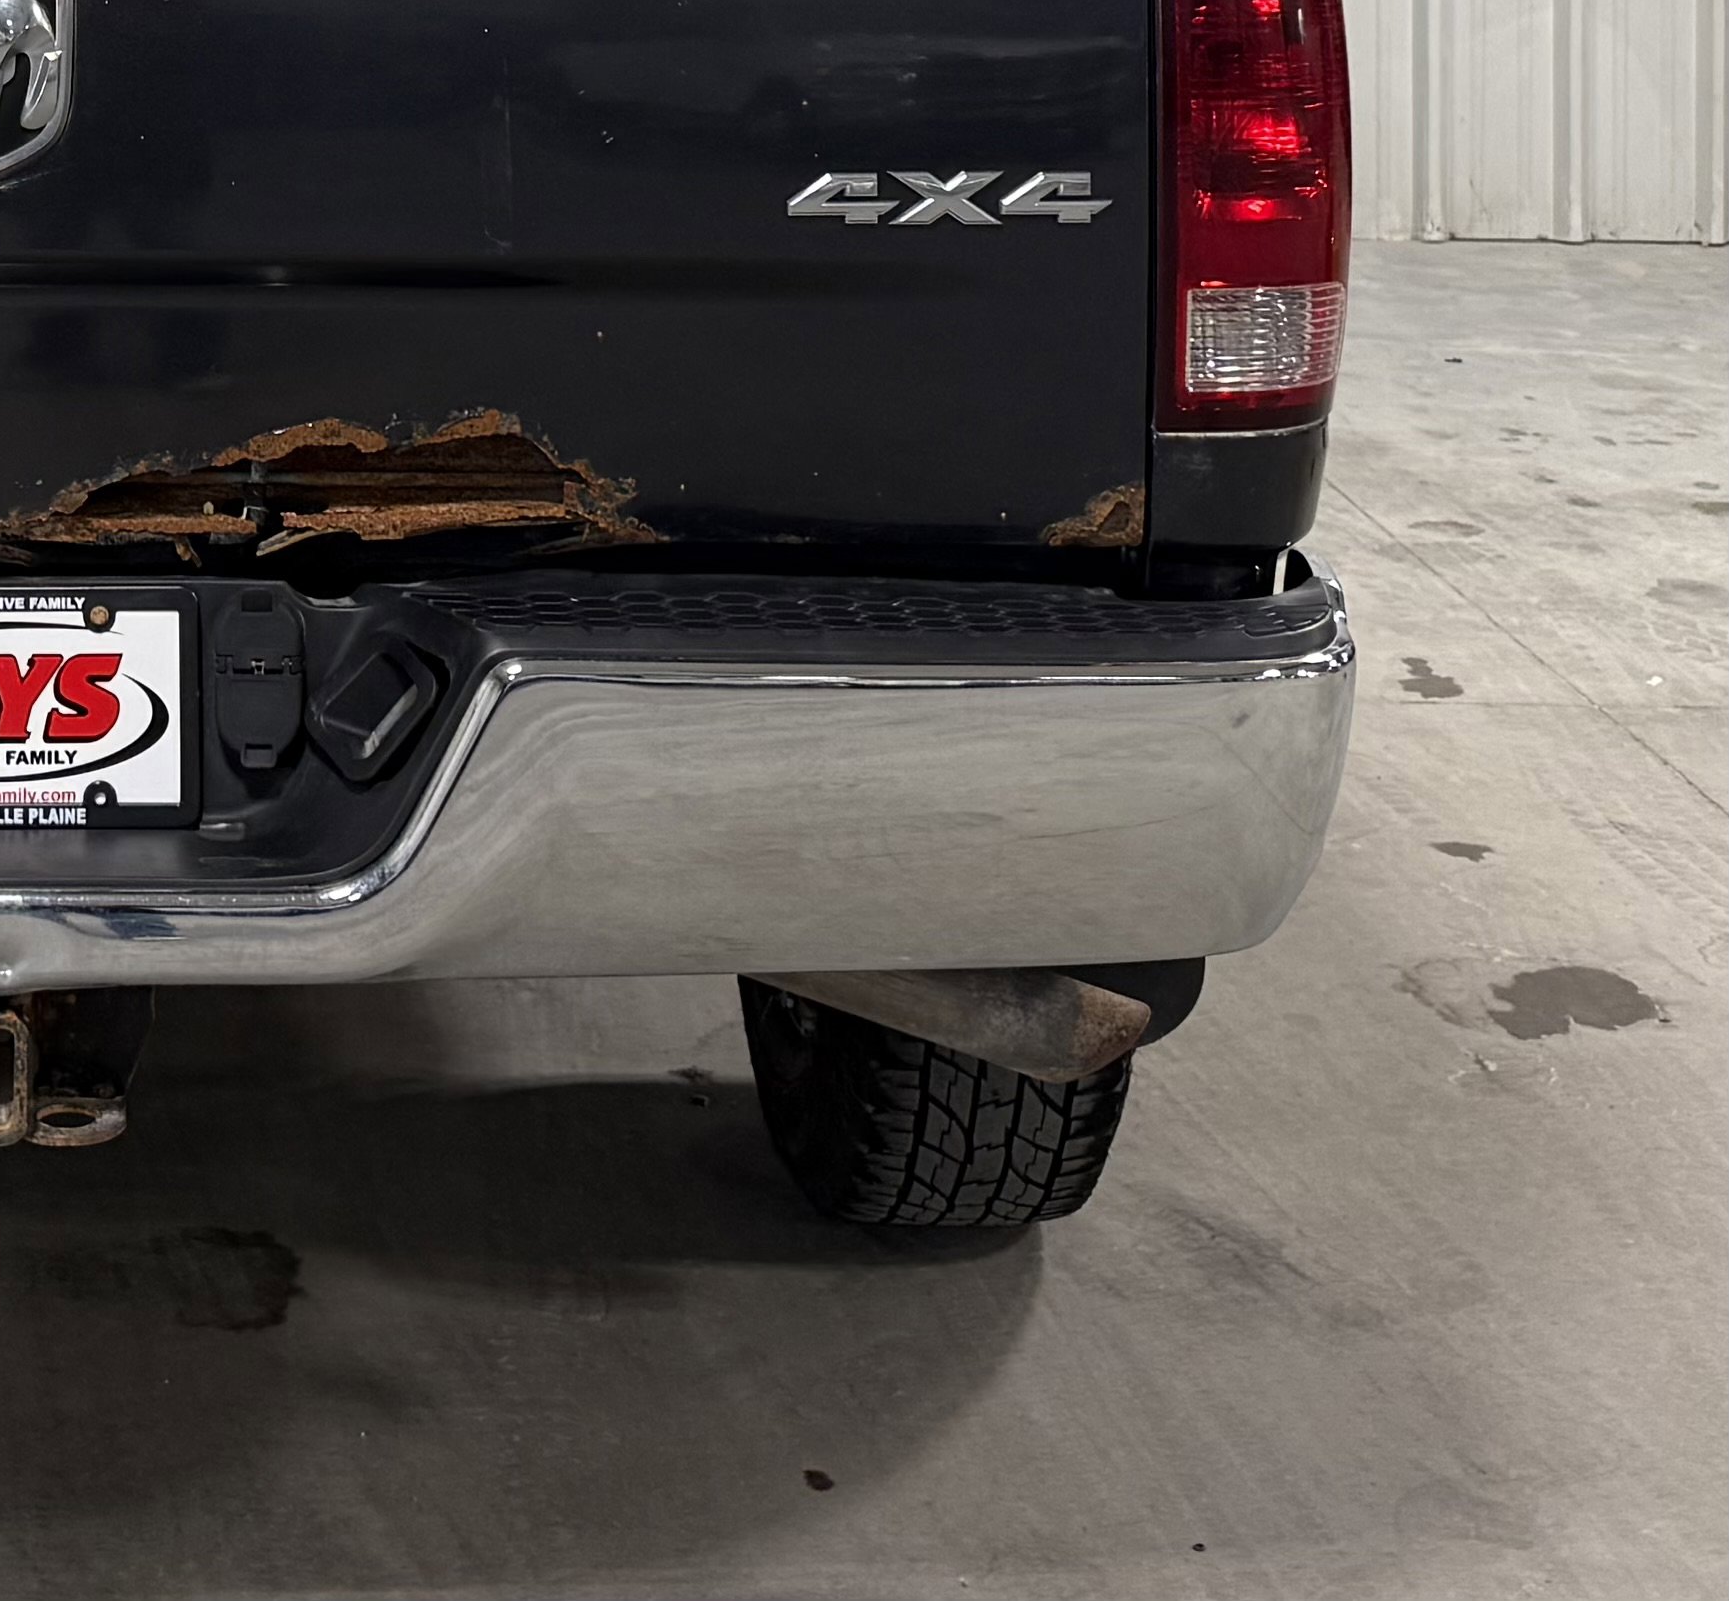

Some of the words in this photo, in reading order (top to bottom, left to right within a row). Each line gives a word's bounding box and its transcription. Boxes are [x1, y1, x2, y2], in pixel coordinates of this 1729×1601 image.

[787, 170, 1113, 225] 4X4
[29, 596, 86, 610] FAMILY
[5, 750, 78, 766] FAMILY
[28, 808, 87, 825] PLAINE
